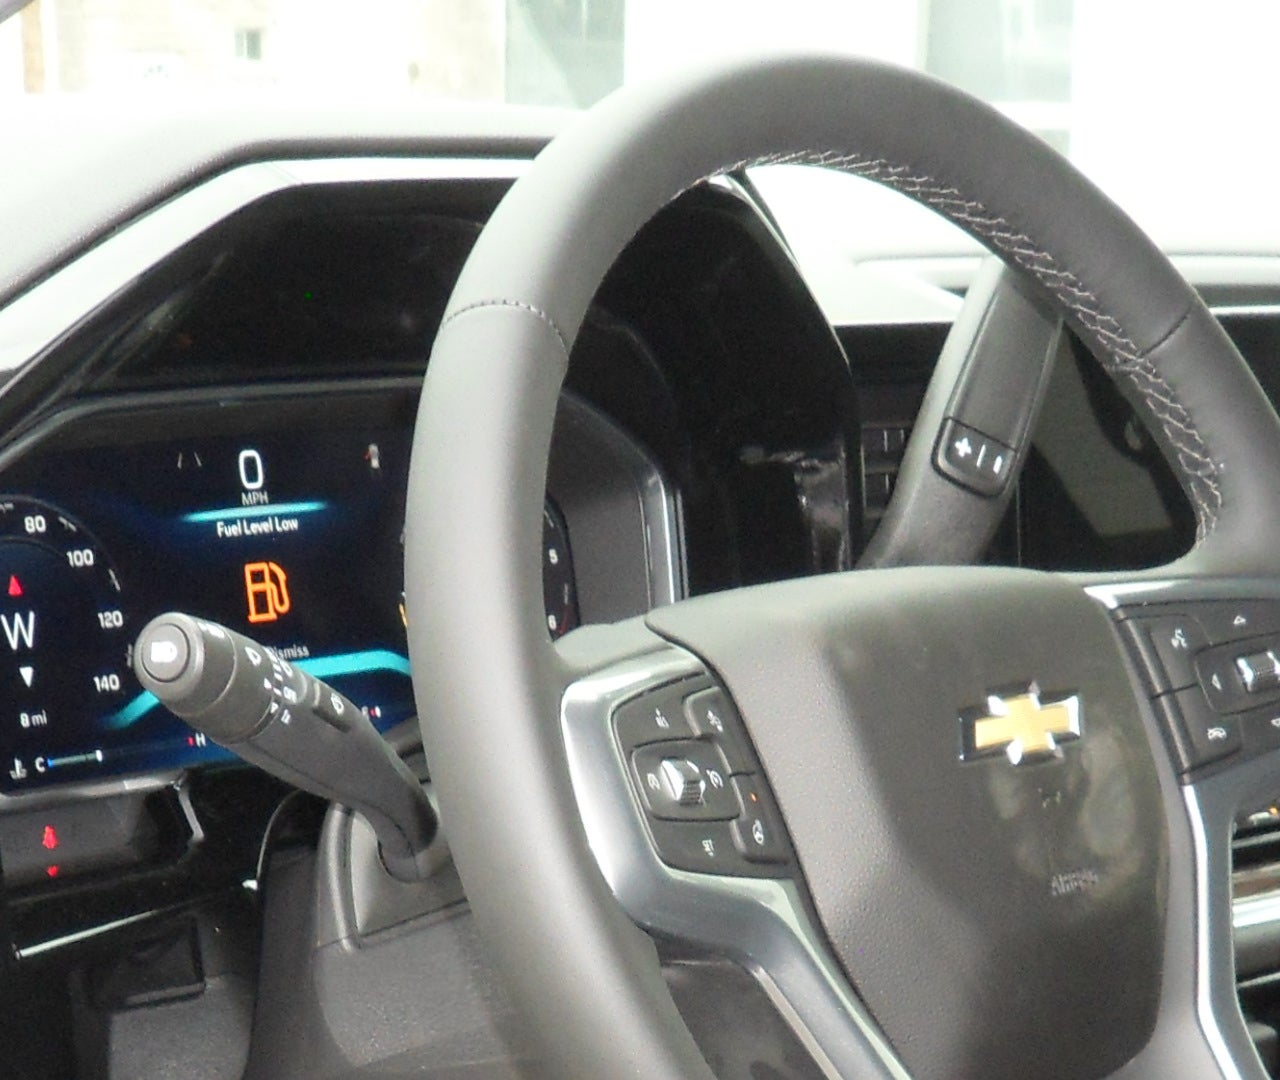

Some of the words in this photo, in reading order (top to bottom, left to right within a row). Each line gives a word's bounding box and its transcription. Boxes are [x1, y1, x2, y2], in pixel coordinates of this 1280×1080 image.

[237, 448, 265, 491] 0
[241, 491, 269, 506] MPH
[24, 514, 47, 534] 80
[216, 520, 243, 539] Fuel
[244, 517, 274, 536] Level
[275, 515, 299, 533] Low
[66, 548, 94, 568] 100
[97, 610, 123, 629] 120
[0, 610, 36, 651] W
[93, 673, 120, 692] 140
[31, 709, 48, 726] mi
[194, 732, 207, 747] H
[34, 756, 46, 773] C
